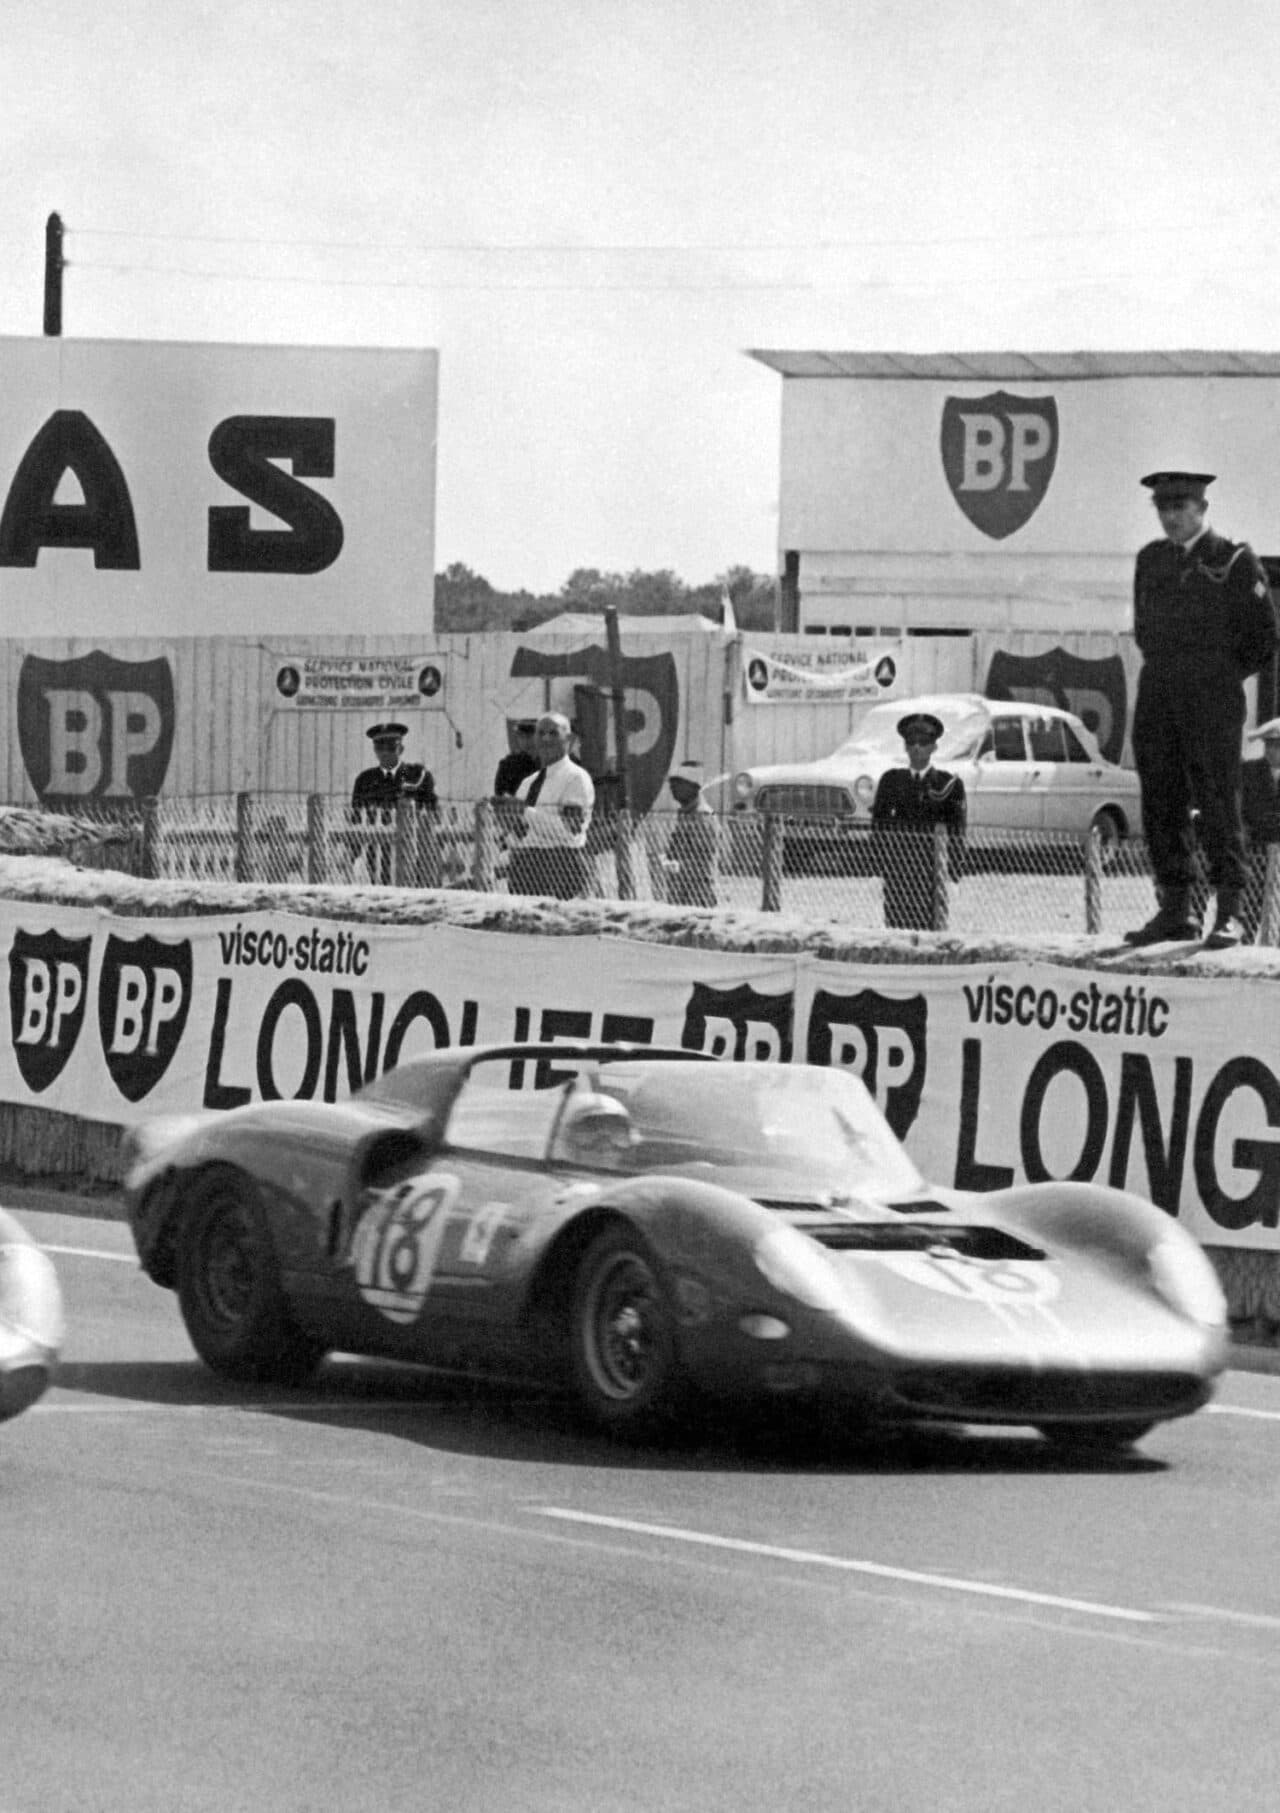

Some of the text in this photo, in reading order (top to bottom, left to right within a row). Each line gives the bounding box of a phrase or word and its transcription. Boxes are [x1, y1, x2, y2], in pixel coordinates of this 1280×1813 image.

[958, 413, 1051, 491] BP
[43, 689, 161, 796] BP
[16, 957, 82, 1048] BP
[108, 964, 182, 1055] BP
[371, 1185, 447, 1290] 18
